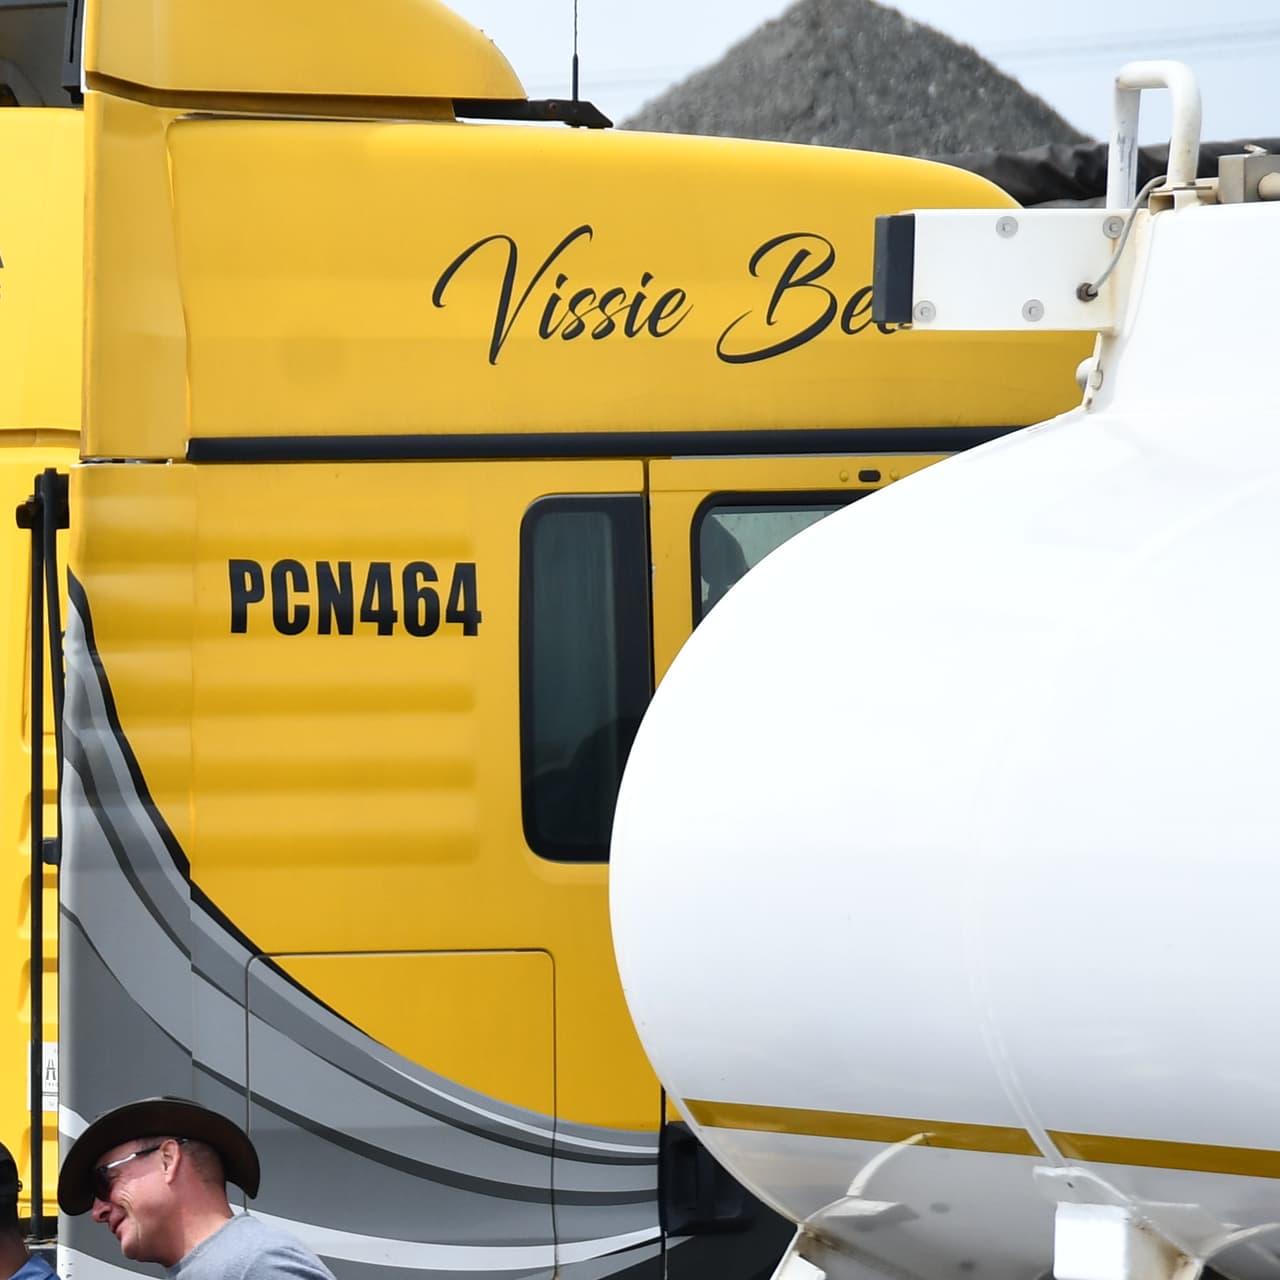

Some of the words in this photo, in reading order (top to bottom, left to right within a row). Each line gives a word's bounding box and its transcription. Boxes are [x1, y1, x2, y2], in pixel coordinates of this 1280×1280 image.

[431, 223, 695, 366] Vissie
[715, 231, 897, 365] Be
[228, 558, 483, 638] PCN464
